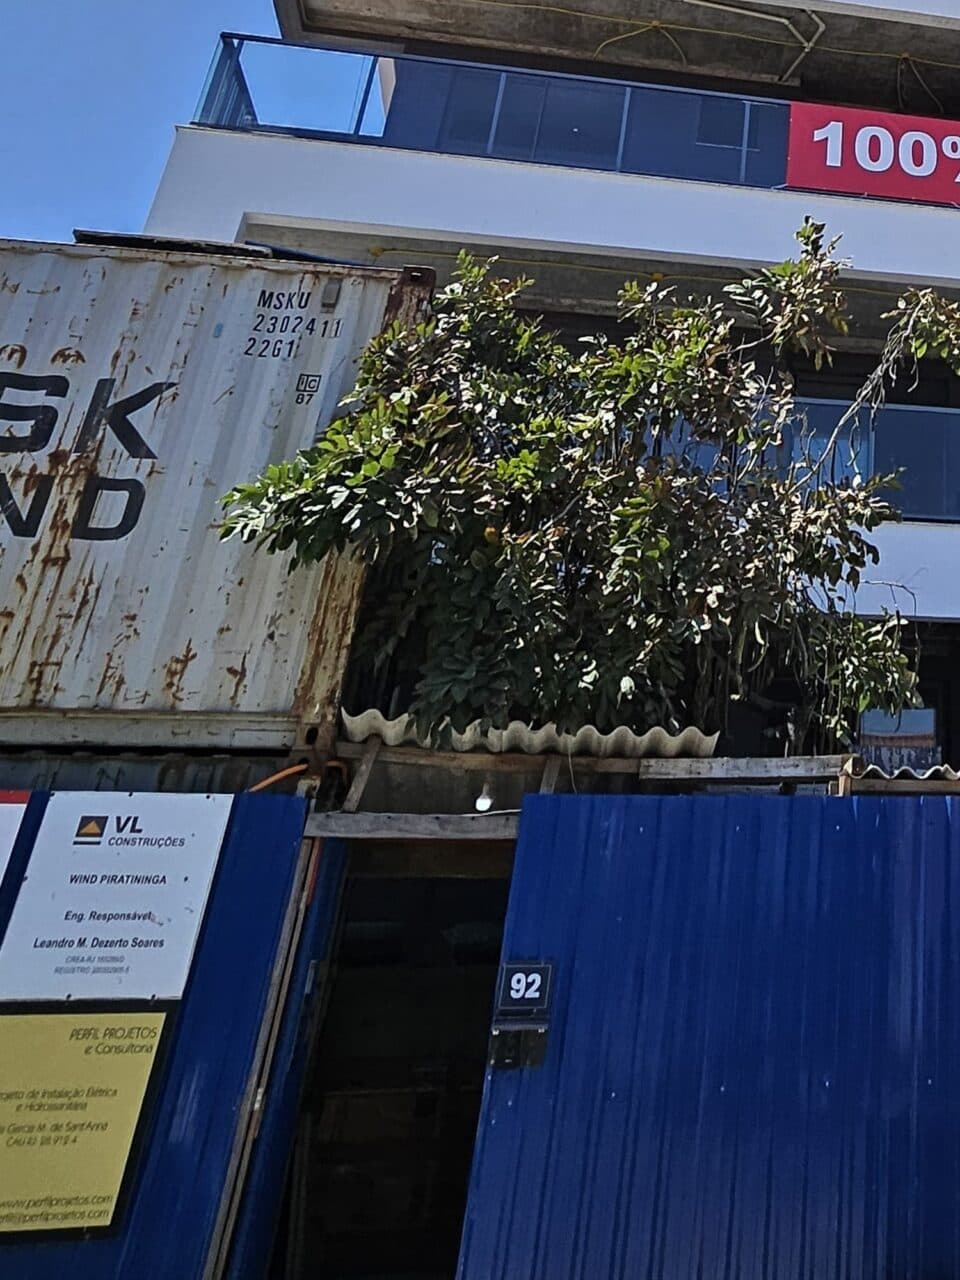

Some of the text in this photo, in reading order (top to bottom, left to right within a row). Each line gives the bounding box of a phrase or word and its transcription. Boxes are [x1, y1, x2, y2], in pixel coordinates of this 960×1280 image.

[256, 288, 312, 310] MSKU
[252, 313, 342, 338] 2302411
[244, 336, 296, 358] 22G1
[295, 393, 314, 405] 87
[114, 815, 144, 834] VL
[107, 836, 186, 849] CONSTRUÇÕES
[69, 874, 167, 885] WIND PIRATININGA
[64, 910, 152, 923] Eng. Responsável
[33, 937, 165, 949] Leandro M. Dezerto Soares
[510, 972, 542, 999] 92
[69, 1026, 157, 1040] PERFIL PROJETOS
